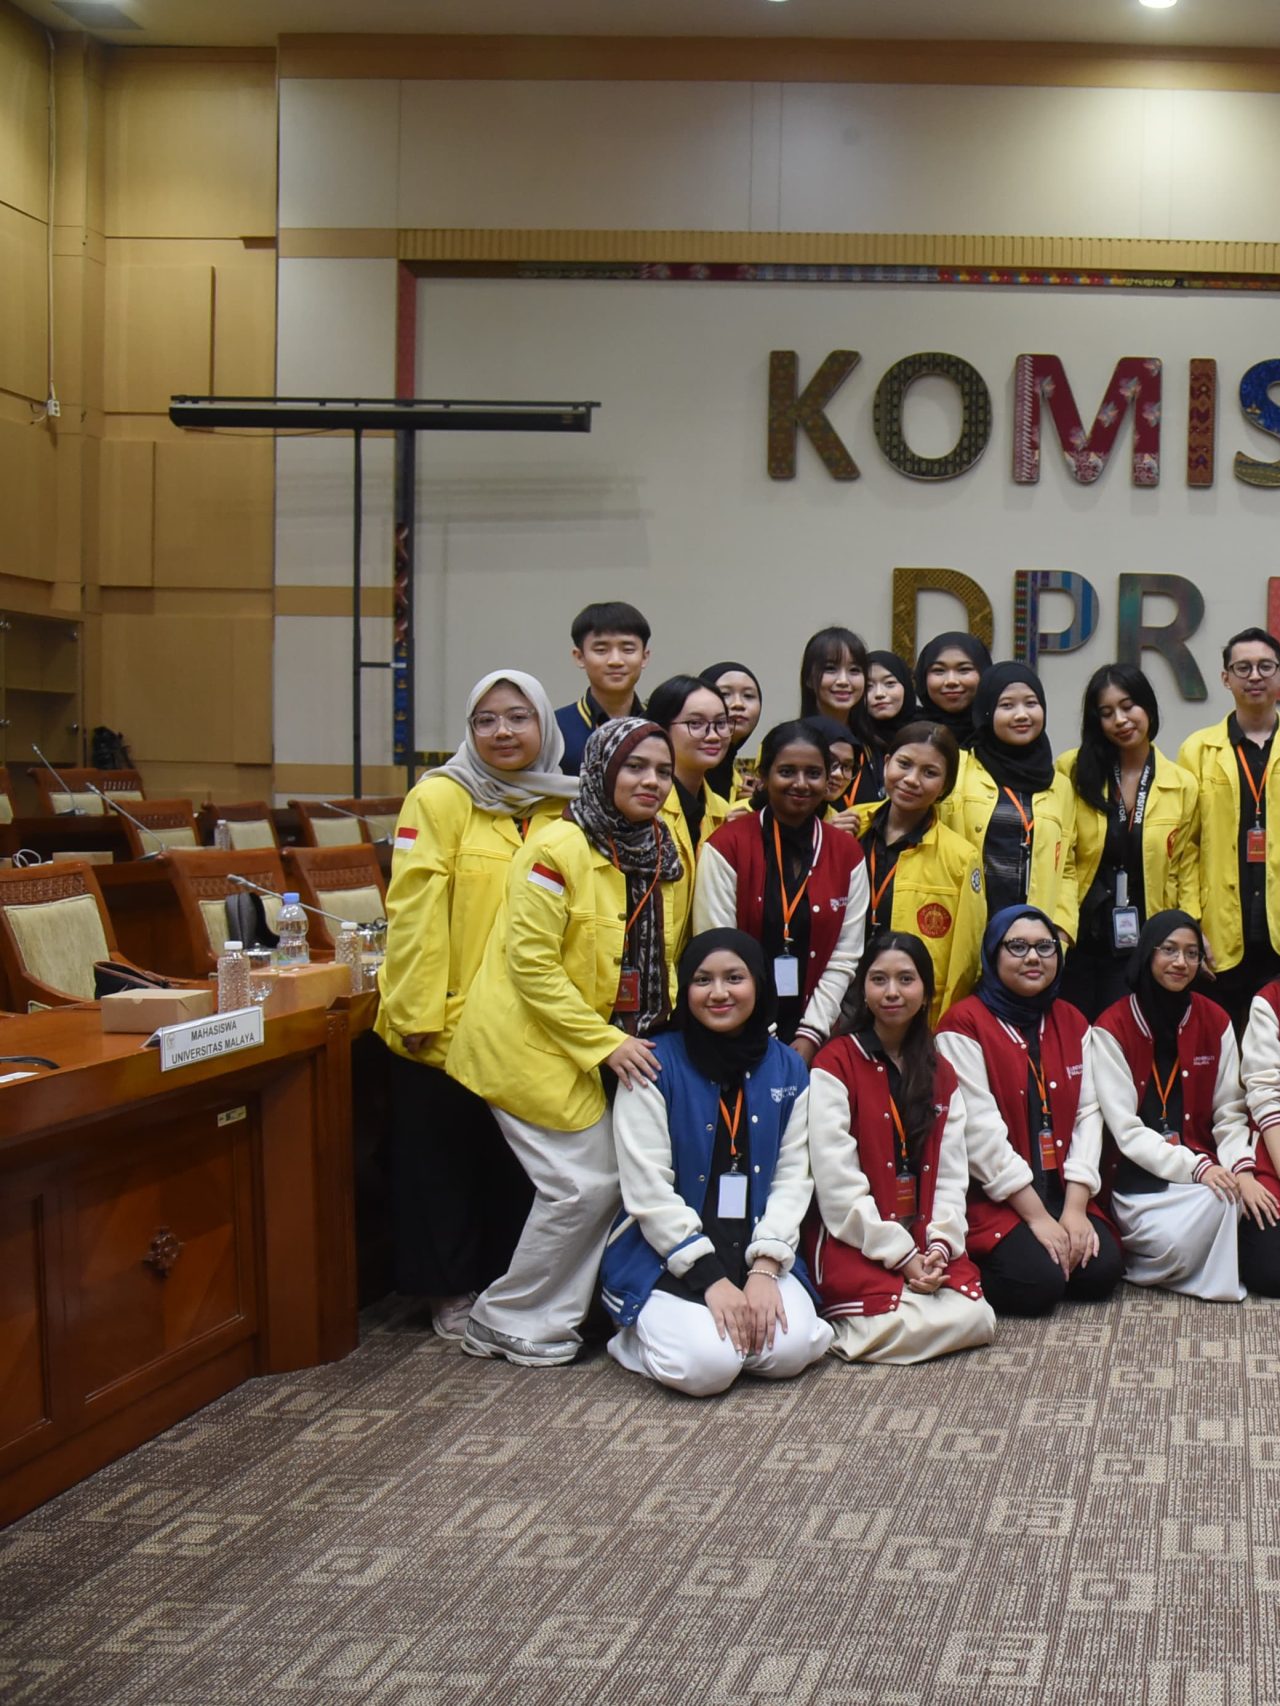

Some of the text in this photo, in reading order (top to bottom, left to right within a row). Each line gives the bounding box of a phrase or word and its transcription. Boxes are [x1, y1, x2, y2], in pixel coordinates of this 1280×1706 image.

[891, 567, 1209, 702] DPR
[1134, 791, 1147, 824] VISITOR
[191, 1020, 237, 1041] MAHASISWA
[171, 1032, 255, 1064] UNIVERSITAS MALAYA
